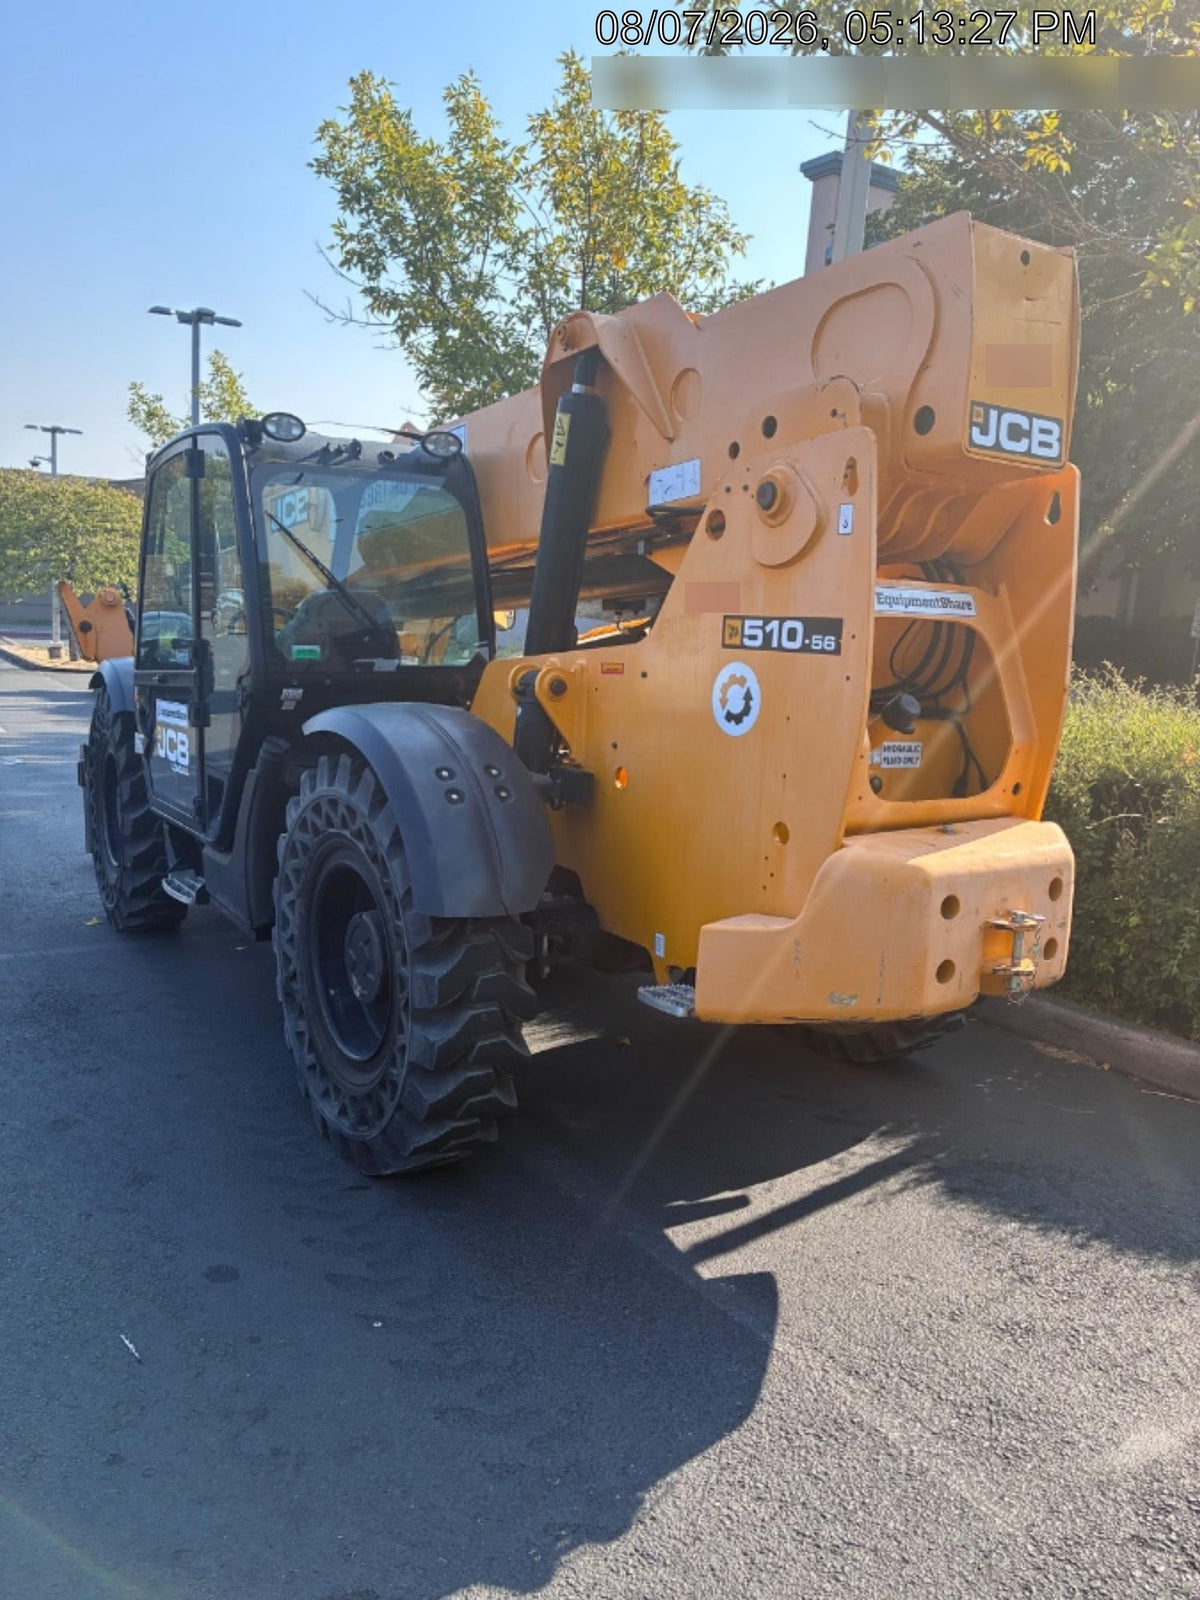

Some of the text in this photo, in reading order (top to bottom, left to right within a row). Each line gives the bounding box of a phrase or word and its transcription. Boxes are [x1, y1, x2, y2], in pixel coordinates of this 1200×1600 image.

[971, 408, 1060, 458] JCB
[876, 592, 973, 610] EquipmentShare
[157, 727, 189, 767] JCB
